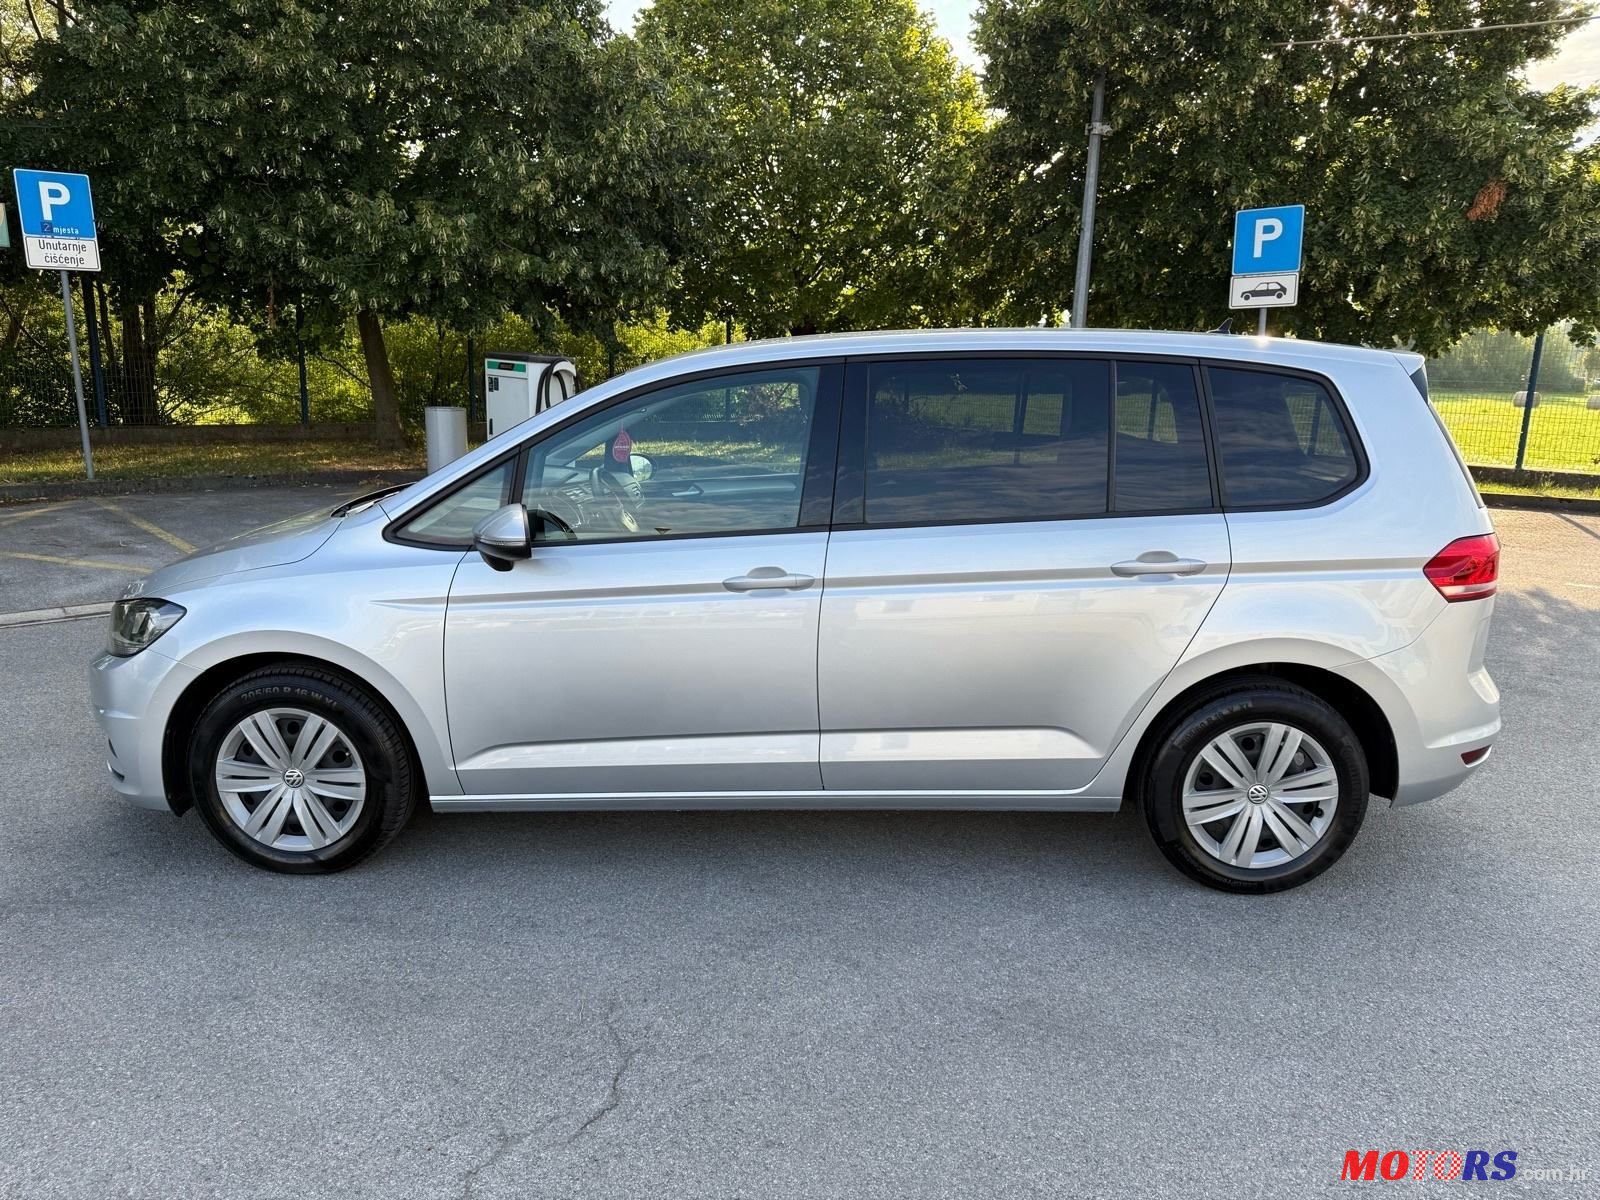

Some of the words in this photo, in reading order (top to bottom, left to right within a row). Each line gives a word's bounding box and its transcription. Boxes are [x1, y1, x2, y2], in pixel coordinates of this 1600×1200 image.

[38, 181, 71, 221] P
[52, 226, 79, 235] mjesta
[1252, 217, 1284, 258] P
[38, 239, 87, 254] Unutarnje
[44, 252, 85, 267] čišćenje
